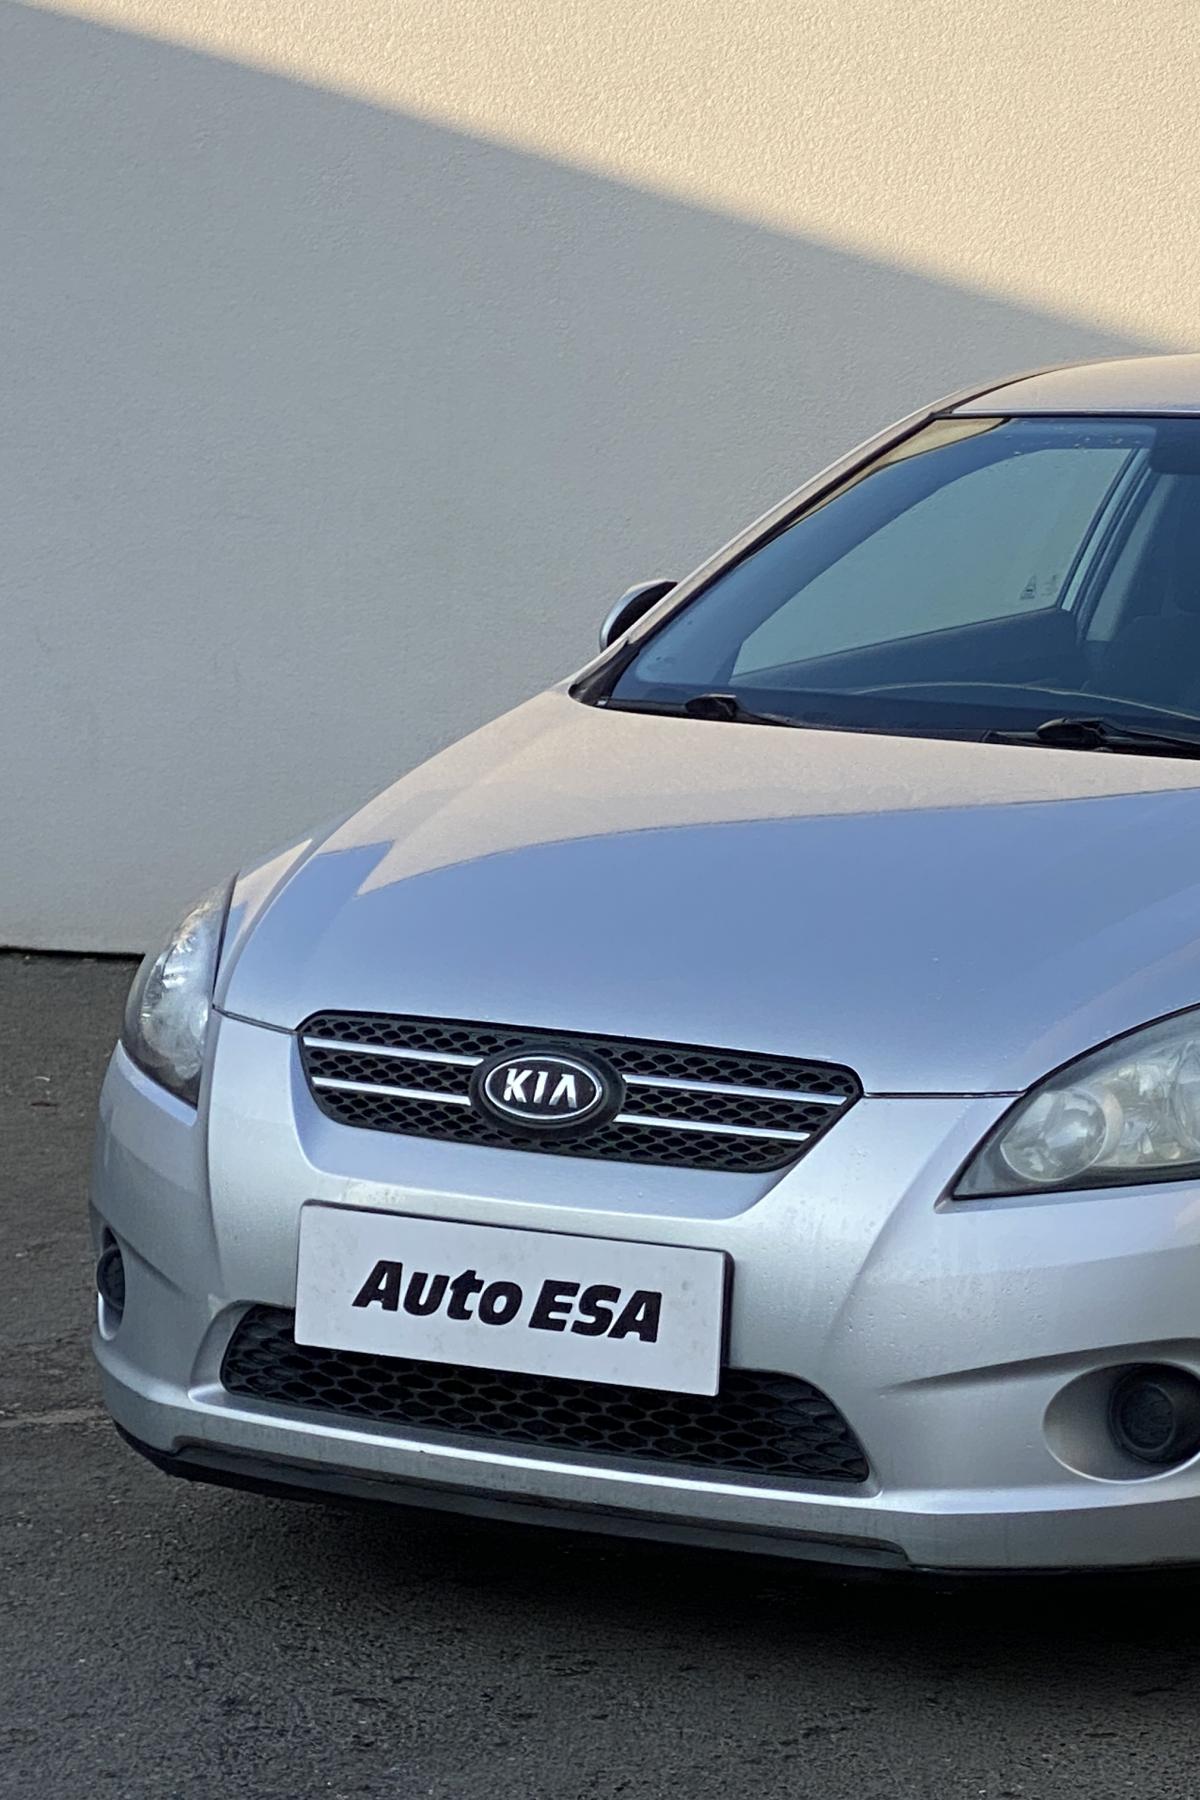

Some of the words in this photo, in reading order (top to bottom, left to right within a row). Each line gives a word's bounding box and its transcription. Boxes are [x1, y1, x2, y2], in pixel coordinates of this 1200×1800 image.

[503, 1068, 577, 1108] KIA
[352, 1260, 523, 1327] Auto
[529, 1279, 662, 1343] ESA
